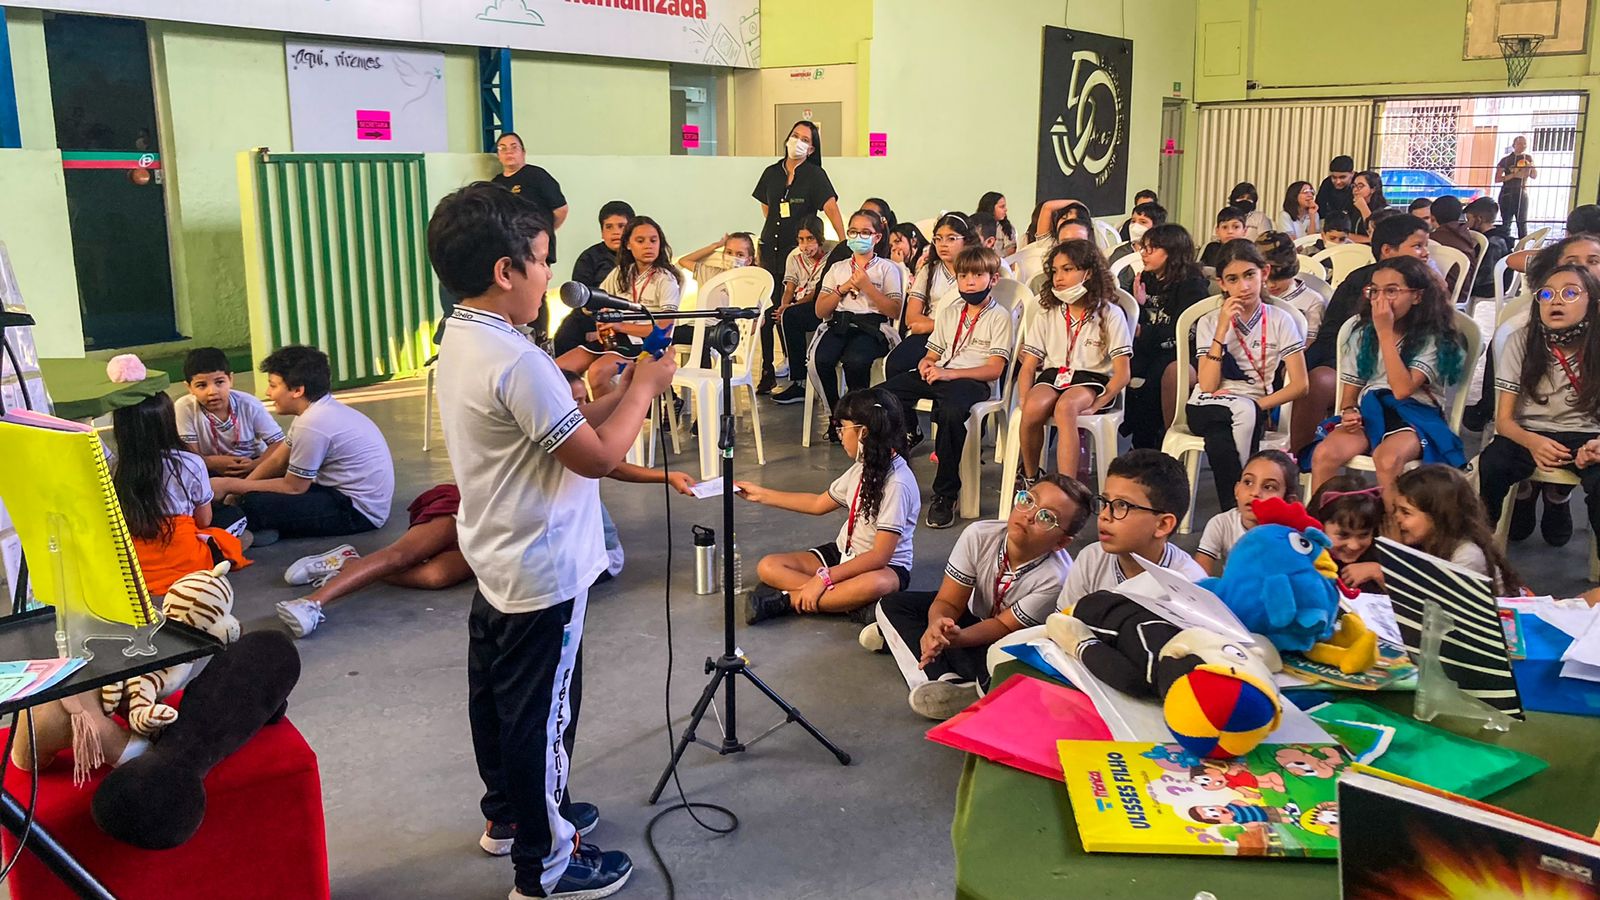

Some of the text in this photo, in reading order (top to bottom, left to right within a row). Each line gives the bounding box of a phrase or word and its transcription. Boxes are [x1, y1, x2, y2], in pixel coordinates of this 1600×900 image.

[565, 0, 707, 19] anizada
[1107, 752, 1151, 830] ULISSES FILHO
